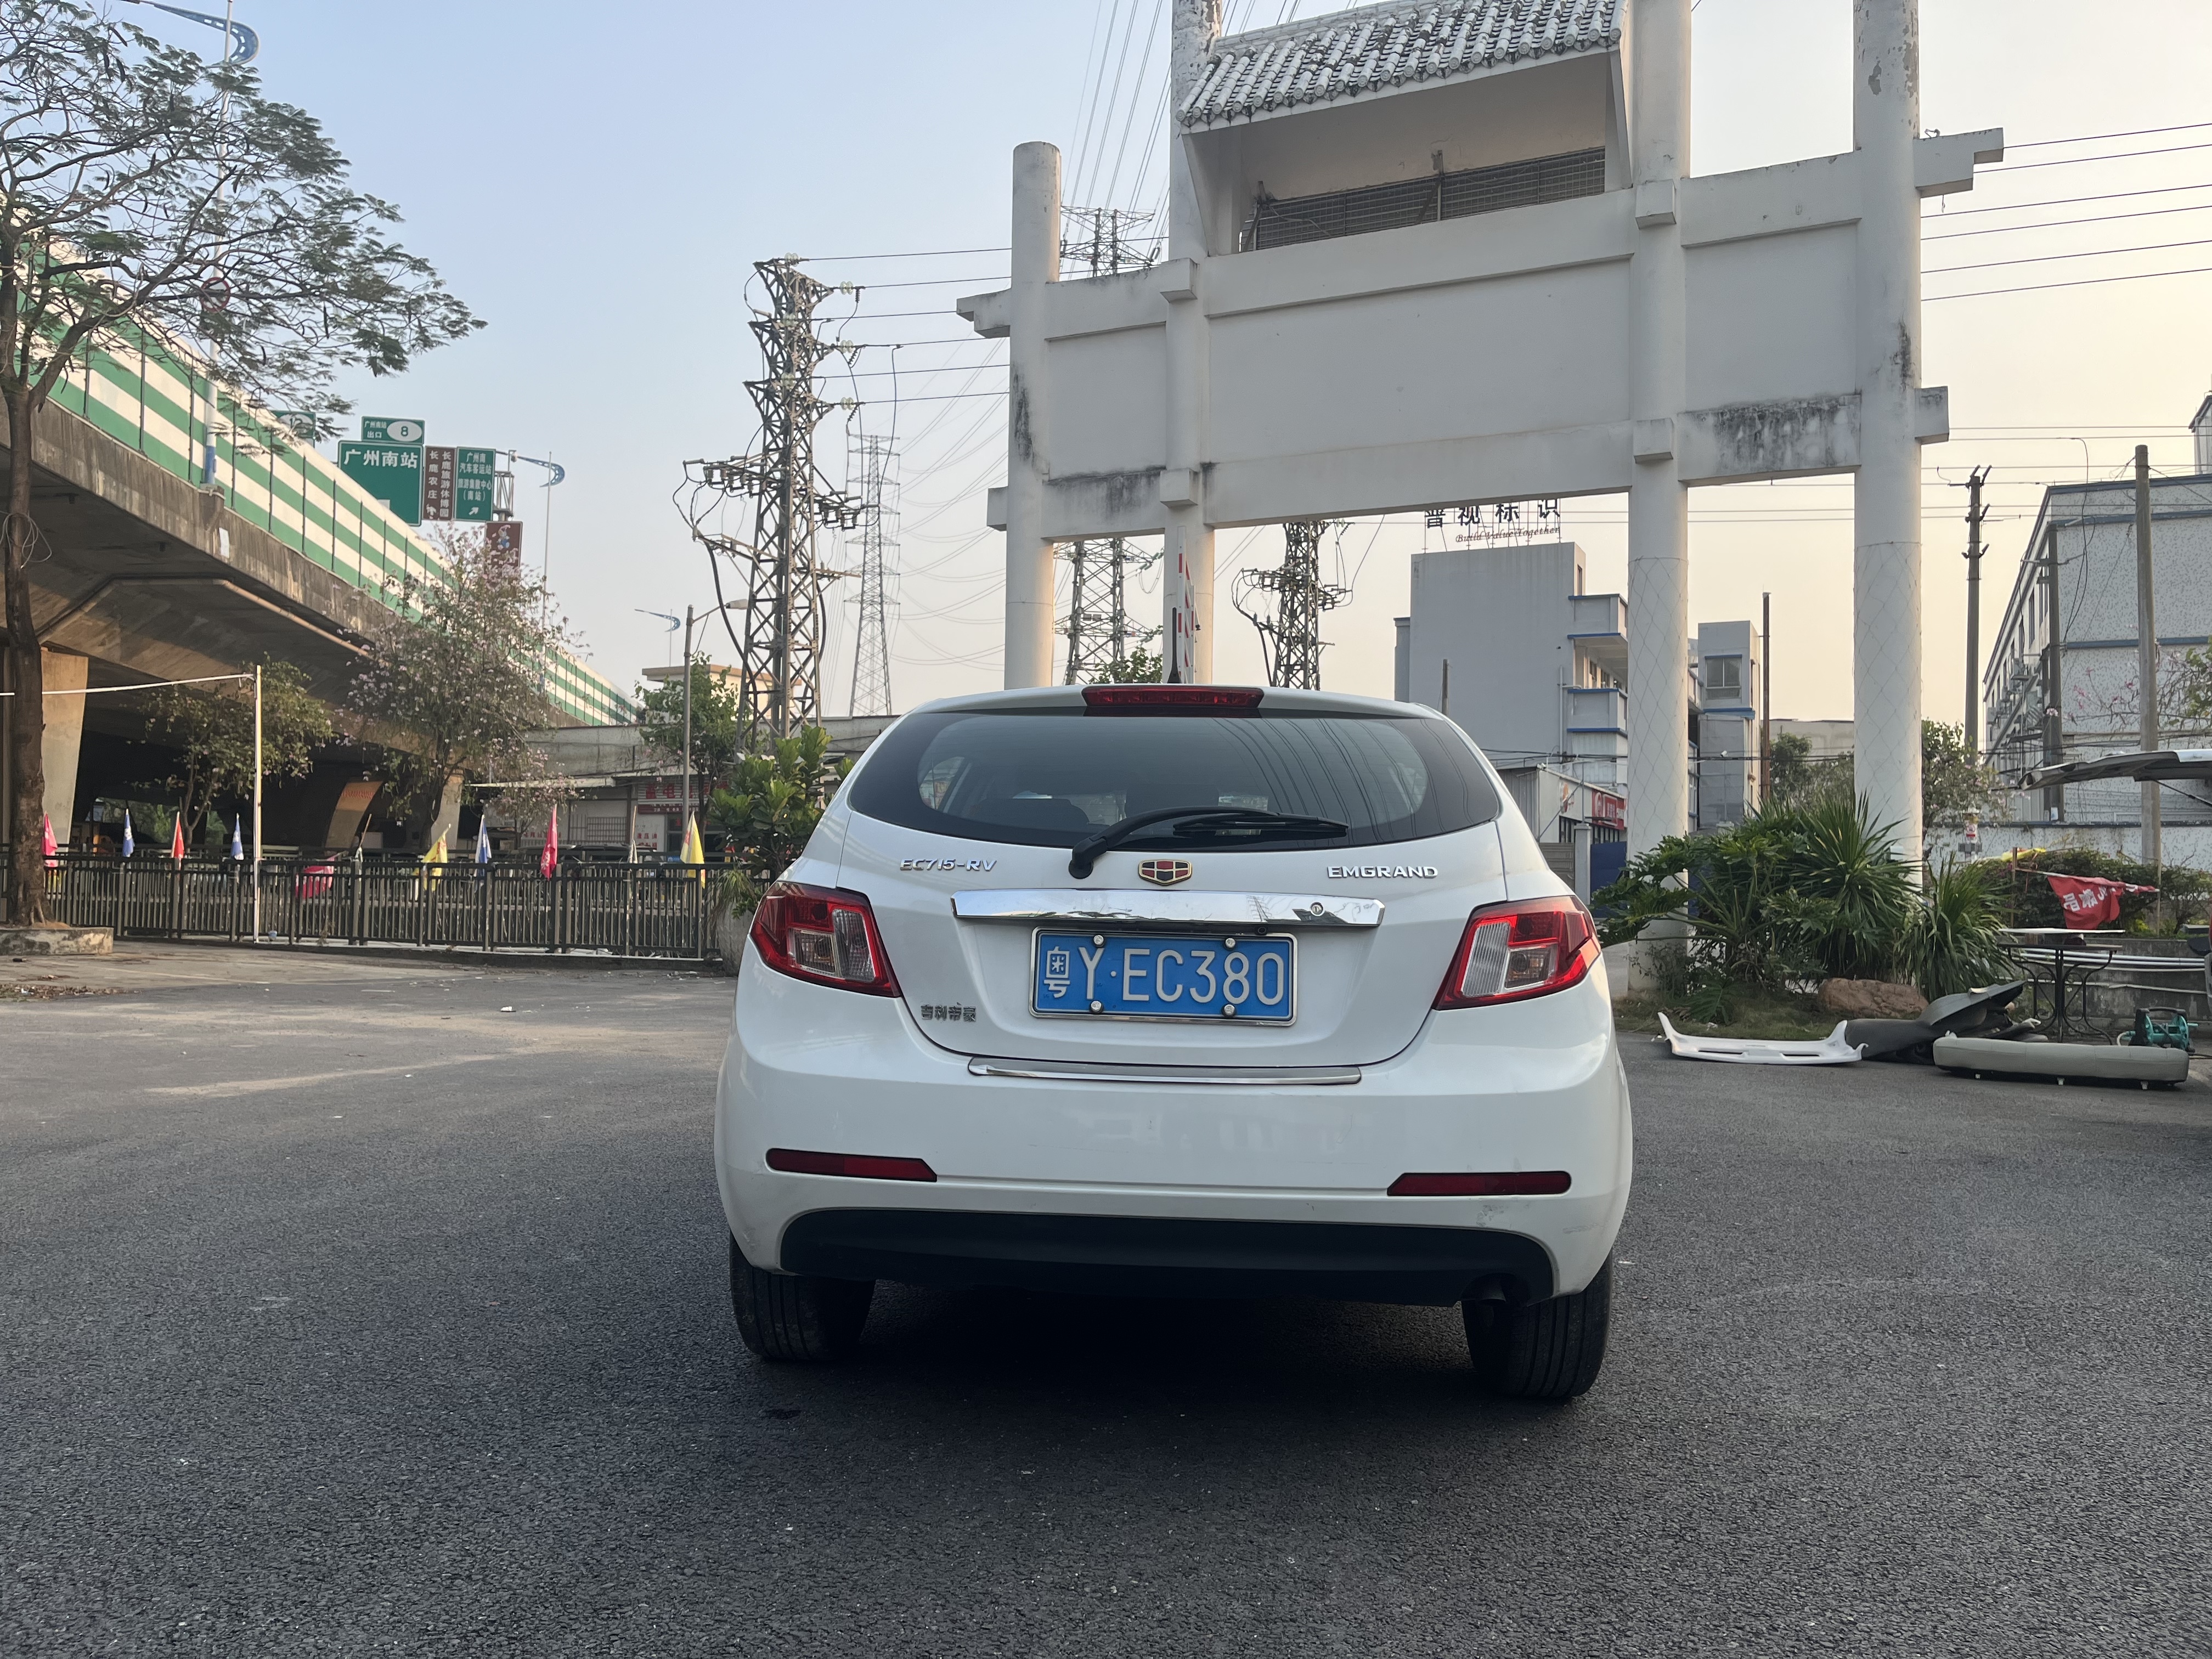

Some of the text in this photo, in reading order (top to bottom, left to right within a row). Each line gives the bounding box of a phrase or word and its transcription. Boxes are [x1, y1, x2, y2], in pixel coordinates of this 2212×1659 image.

[366, 430, 382, 438] 出口
[400, 426, 408, 437] 8
[343, 449, 418, 469] 广州南站
[466, 452, 486, 463] 广州南
[428, 450, 439, 499] 长鹿农庄
[459, 462, 492, 475] 汽车客运站
[440, 450, 452, 517] 长鹿旅游休博园
[1455, 530, 1484, 543] Build
[900, 853, 997, 872] EC715-RV
[1327, 866, 1438, 878] EMGRAND
[921, 1003, 977, 1022] 吉利帝豪
